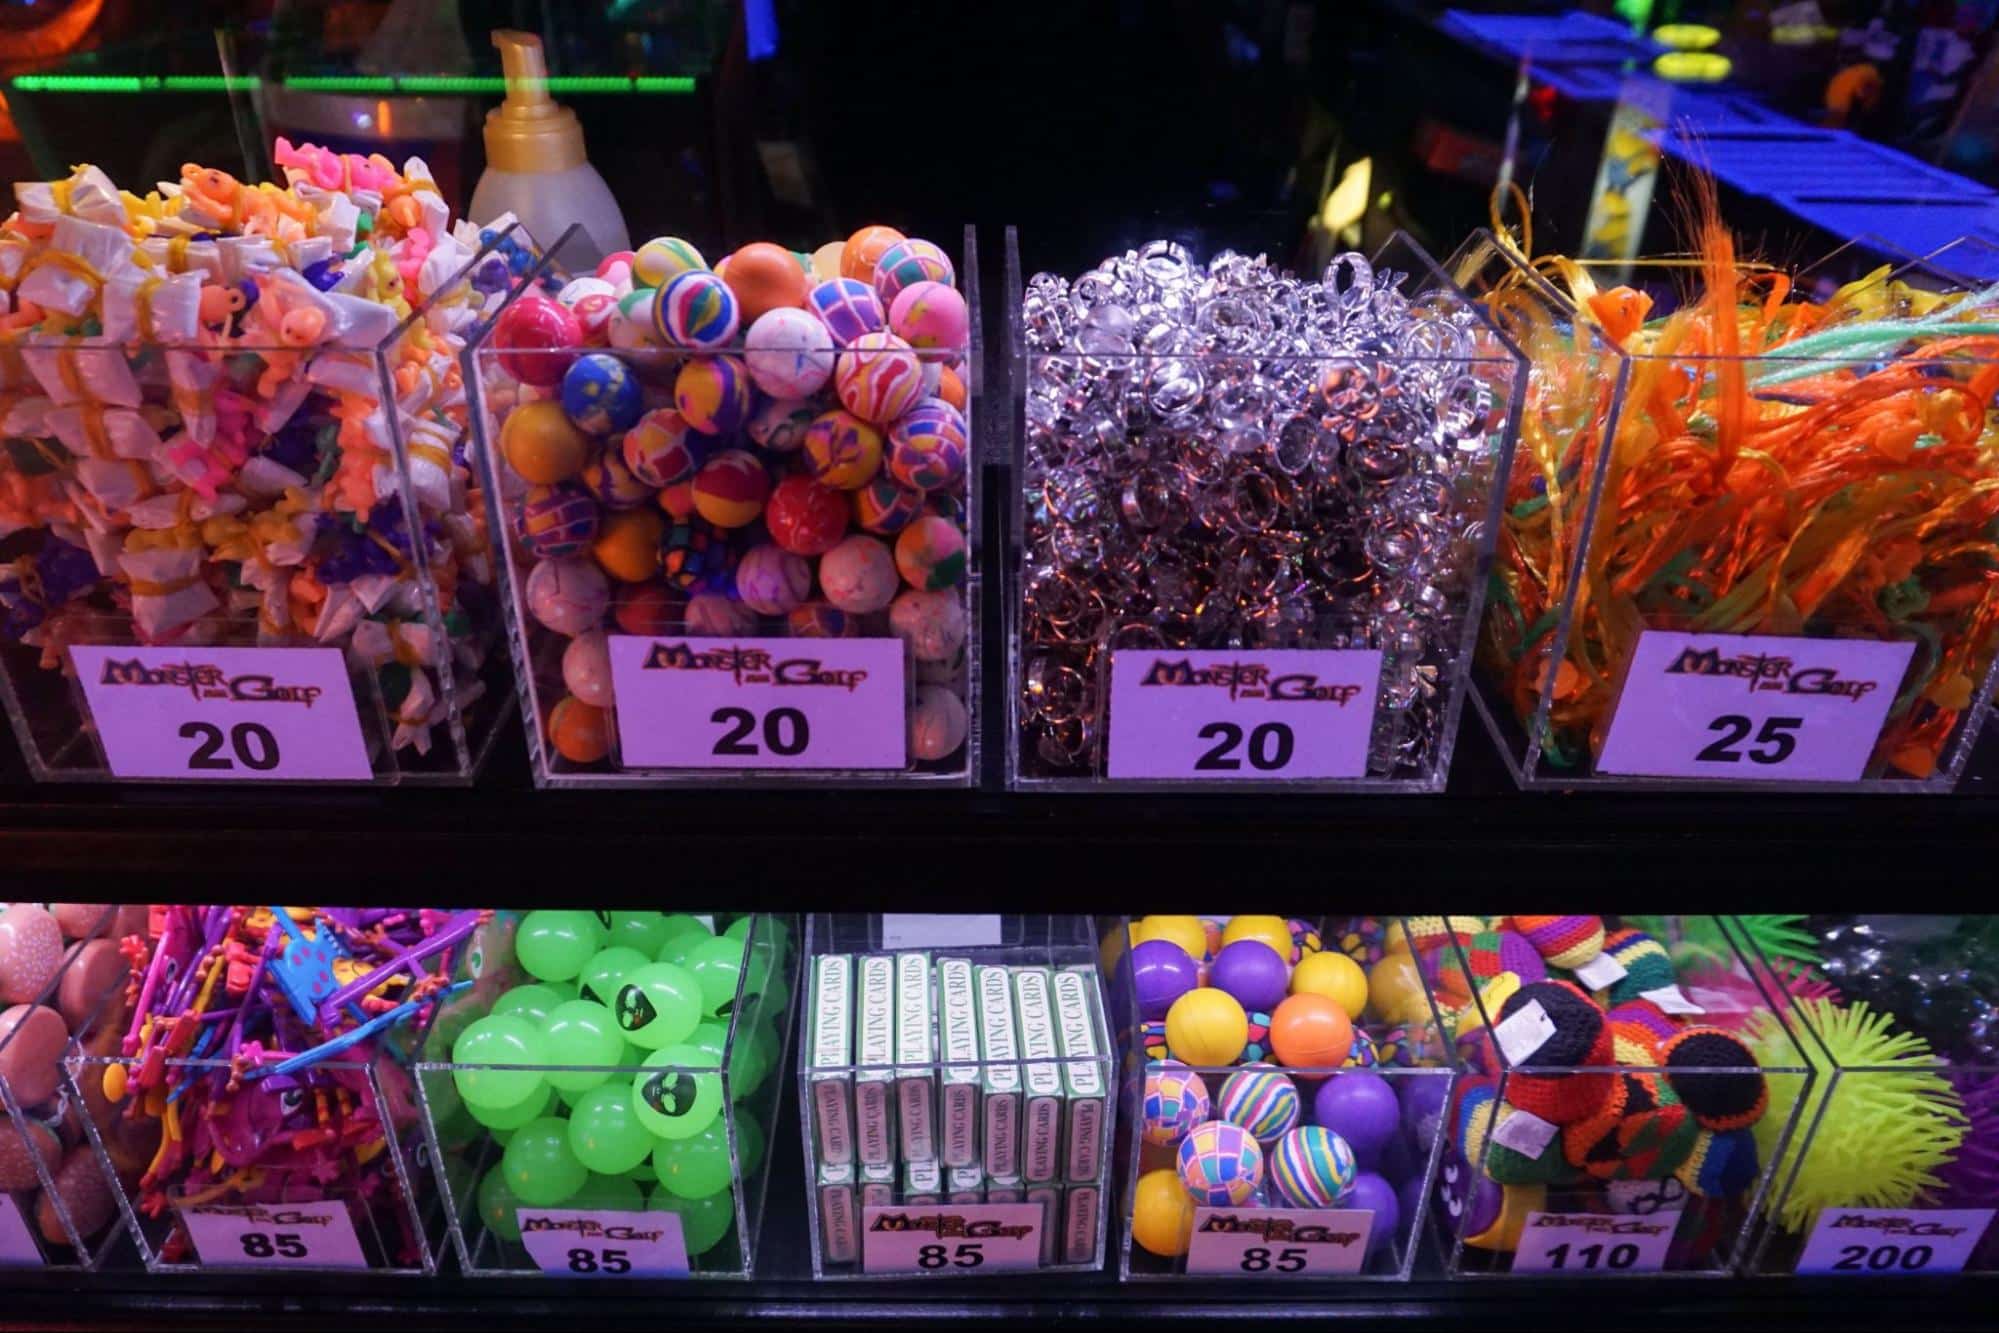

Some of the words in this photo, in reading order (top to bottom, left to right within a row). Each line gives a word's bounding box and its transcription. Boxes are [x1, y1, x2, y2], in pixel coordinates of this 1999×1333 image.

[179, 722, 280, 770] 20
[710, 707, 810, 756] 20
[1194, 722, 1294, 770] 20
[1696, 715, 1804, 764] 25
[823, 960, 841, 1003] CARDS
[868, 961, 887, 1004] CARDS
[904, 958, 922, 1000] CARDS
[948, 964, 968, 1007] CARDS
[985, 971, 1005, 1014] CARDS
[1023, 976, 1043, 1018] CARDS
[1059, 976, 1082, 1019] CARDS
[240, 1232, 308, 1258] 85
[568, 1248, 632, 1273] 85
[918, 1244, 984, 1268] 85
[1241, 1248, 1307, 1272] 85
[1546, 1243, 1640, 1269] 110
[1832, 1245, 1934, 1270] 200
